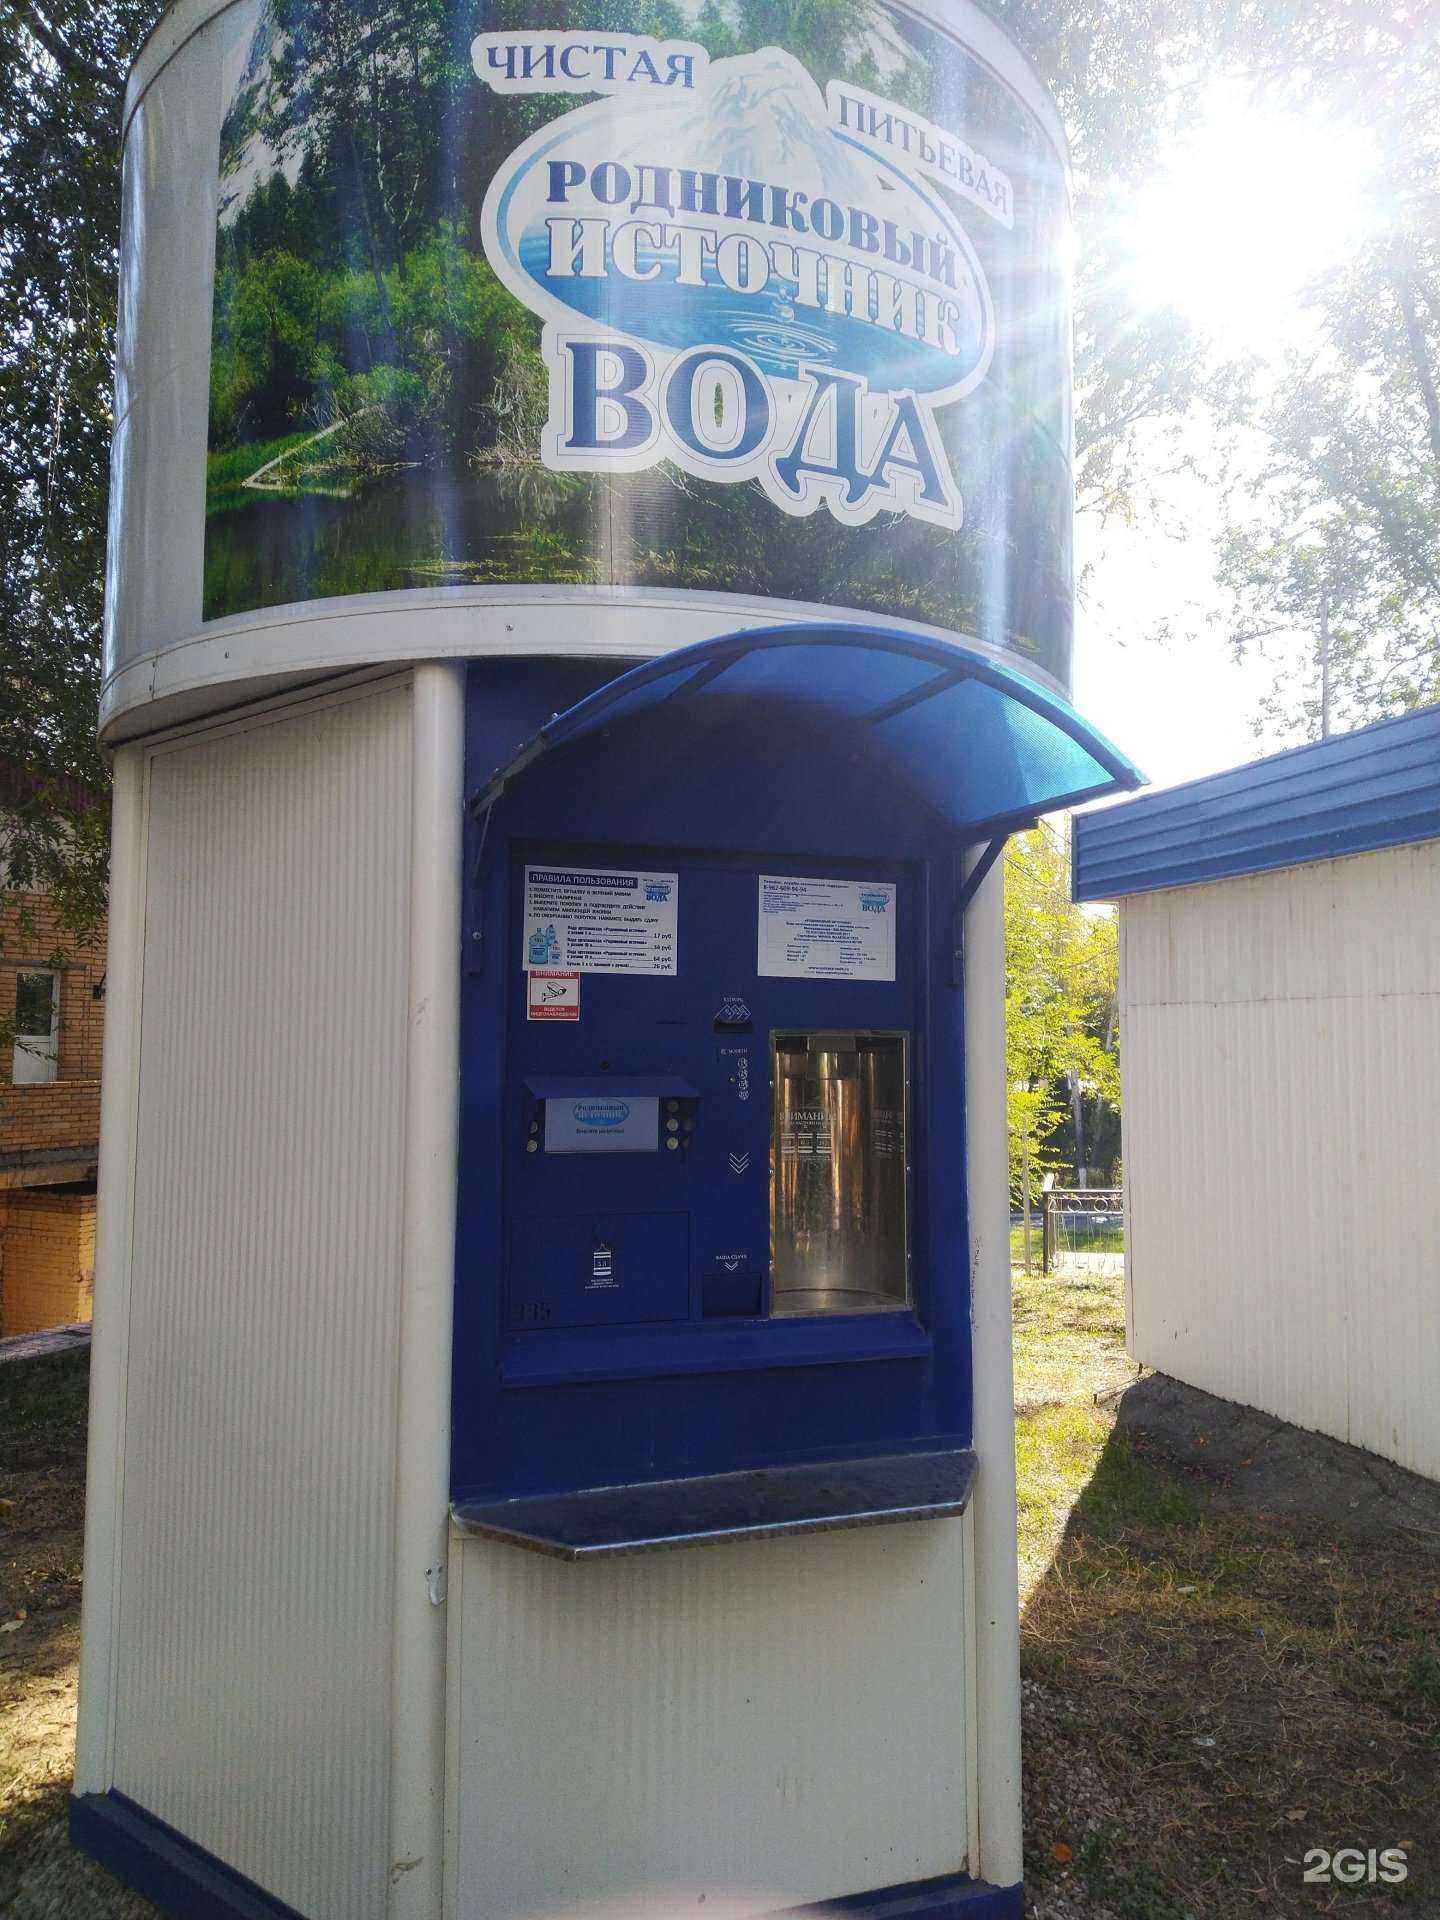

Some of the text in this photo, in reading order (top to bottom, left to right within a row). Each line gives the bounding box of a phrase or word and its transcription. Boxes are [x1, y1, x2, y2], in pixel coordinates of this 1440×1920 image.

[487, 44, 695, 89] ЧИСТАЯ
[840, 93, 1010, 215] ПИТЬЕВАЯ
[545, 218, 961, 355] ИСТОЧНИК
[546, 160, 961, 289] РОДНИКОВЫЙ
[557, 340, 963, 507] ВОДА
[532, 874, 571, 885] ПРАВИЛА
[573, 876, 634, 888] ПОЛЬЗОВАНИЯ
